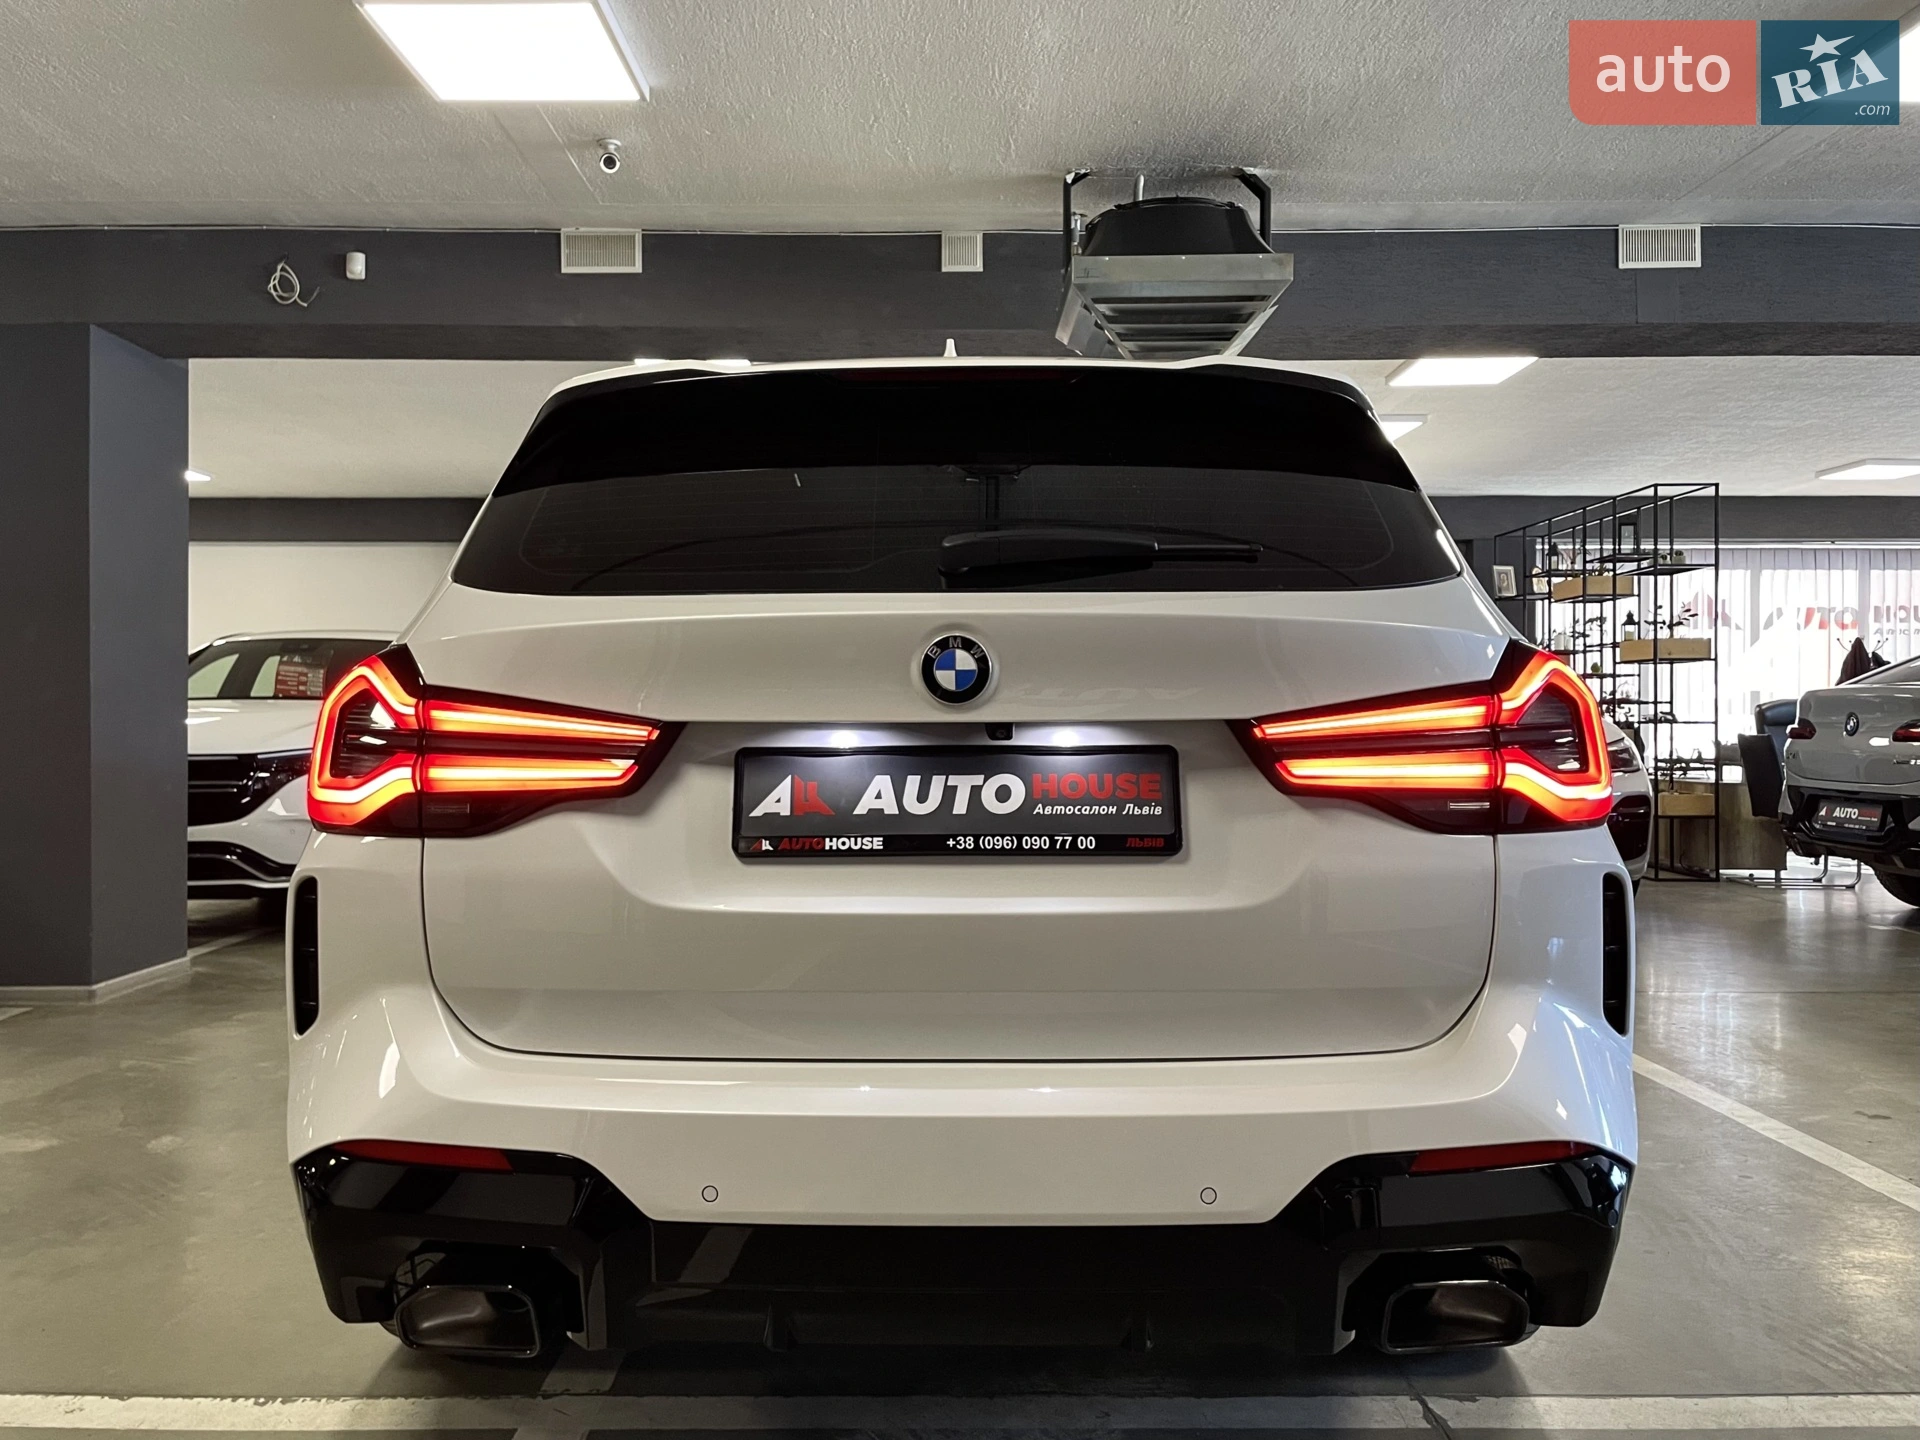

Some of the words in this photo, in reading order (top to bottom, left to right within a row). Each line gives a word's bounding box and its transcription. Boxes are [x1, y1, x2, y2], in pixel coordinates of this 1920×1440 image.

[927, 637, 985, 659] BMW
[852, 773, 1026, 815] AUTO
[1032, 772, 1162, 799] HOUSE
[1033, 803, 1117, 815] Автосалон
[1122, 802, 1163, 815] Львів
[1832, 807, 1858, 819] AUTO
[778, 837, 883, 850] AUTOHOUSE
[947, 836, 974, 849] +38
[979, 835, 1017, 850] (096)
[1022, 836, 1049, 849] 090
[1054, 836, 1072, 849] 77
[1077, 836, 1096, 849] 00
